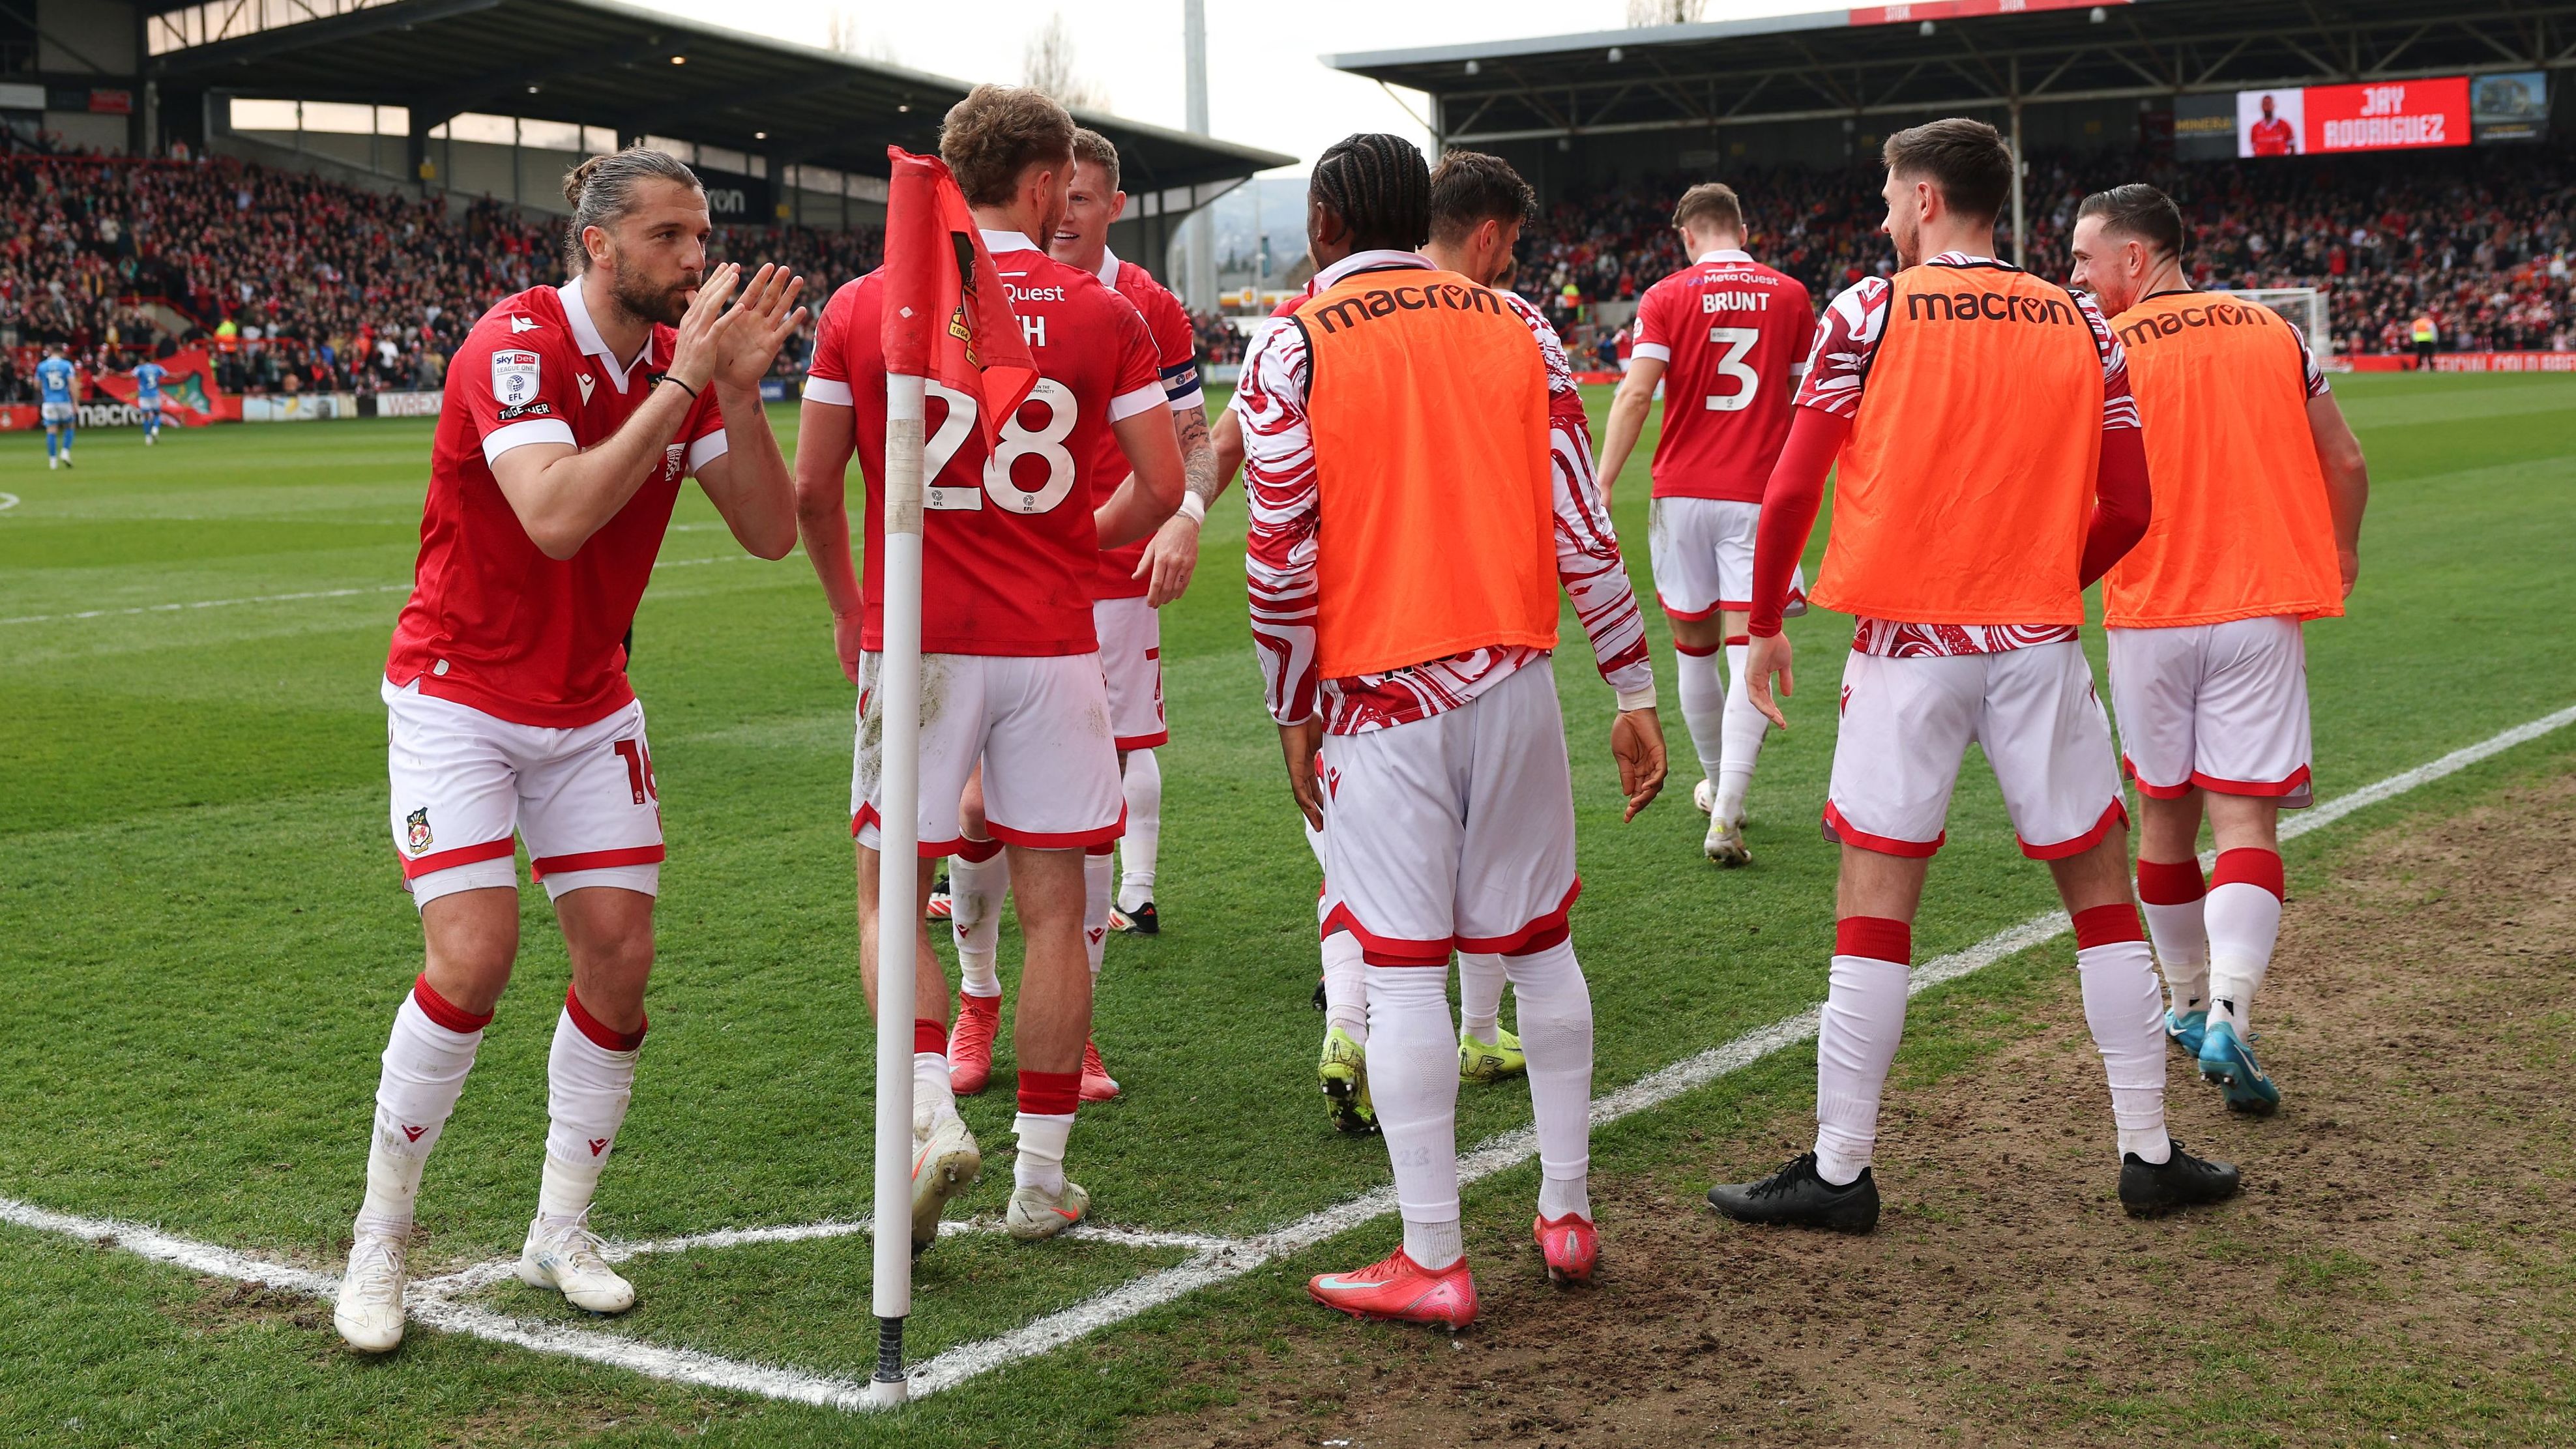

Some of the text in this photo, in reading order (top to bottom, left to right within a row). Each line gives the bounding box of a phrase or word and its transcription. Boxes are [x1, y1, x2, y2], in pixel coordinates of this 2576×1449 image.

[2360, 86, 2405, 116] JAY
[2323, 113, 2445, 148] RODRIGUEZ
[1003, 283, 1065, 303] Quest
[1704, 272, 1779, 286] Meta Quest
[1313, 284, 1501, 334] macron
[1702, 291, 1770, 314] BRUNT
[1907, 292, 2075, 325] macron
[951, 326, 969, 339] 1864
[1017, 315, 1046, 347] H
[2118, 304, 2268, 347] macron
[496, 356, 513, 364] sky
[1705, 327, 1759, 411] 3
[508, 393, 523, 402] EFL
[78, 403, 141, 428] macro
[924, 376, 1078, 515] 28
